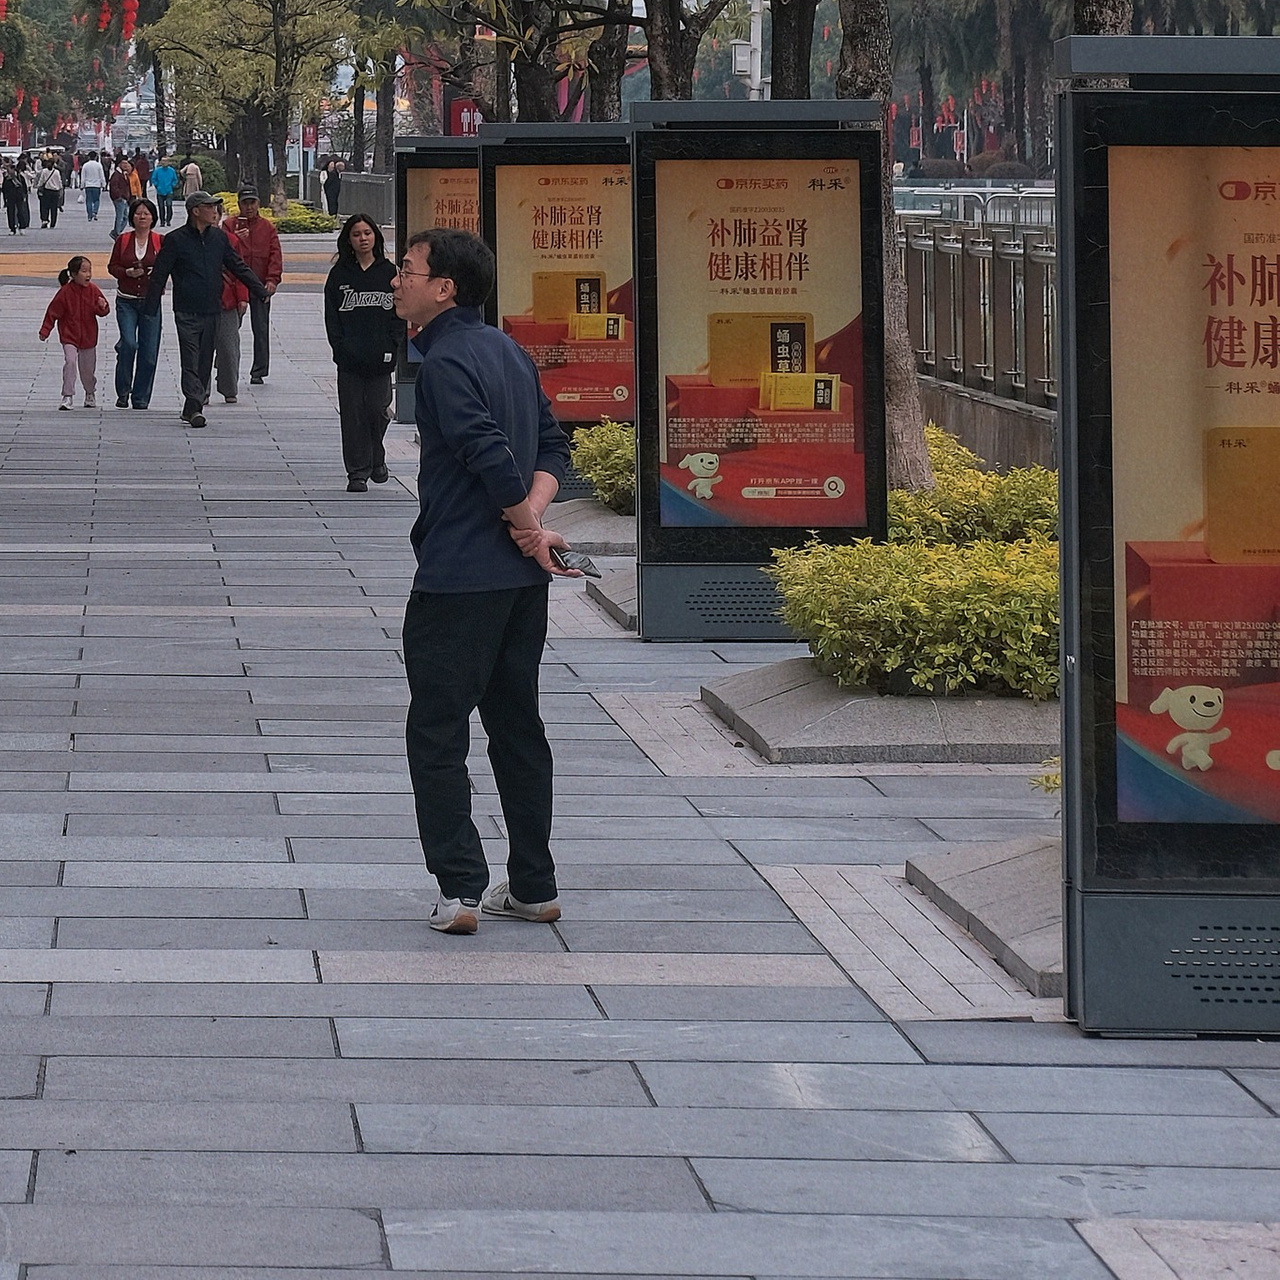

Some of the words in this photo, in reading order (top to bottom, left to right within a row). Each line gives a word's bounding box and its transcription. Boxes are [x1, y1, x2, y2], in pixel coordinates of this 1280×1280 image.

[735, 178, 788, 190] 京东买药
[1253, 181, 1280, 201] 京
[435, 199, 479, 215] 补肺益
[532, 205, 602, 226] 补肺益肾
[435, 217, 479, 233] 健康相
[707, 218, 808, 248] 补肺益肾
[532, 229, 603, 249] 健康相伴
[707, 252, 810, 281] 健康相伴
[1202, 254, 1280, 308] 补肺
[338, 289, 394, 311] LAKERS
[1202, 315, 1280, 369] 健康
